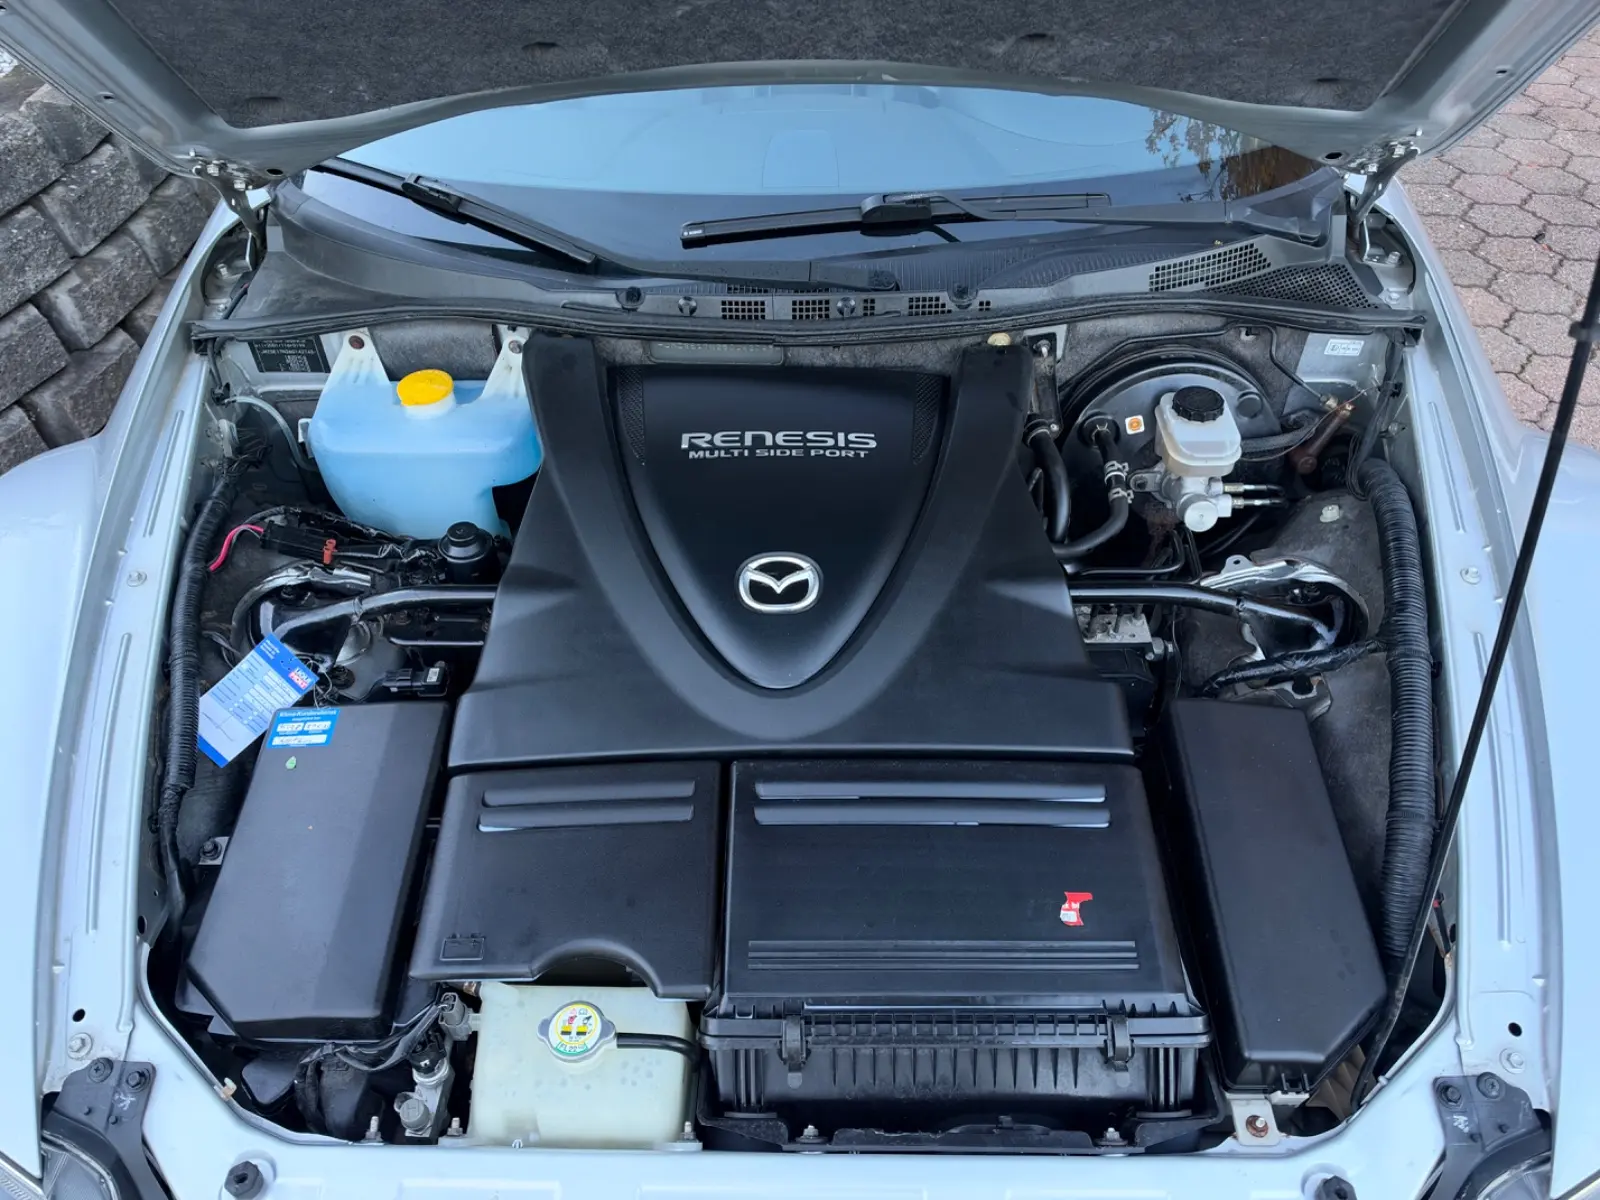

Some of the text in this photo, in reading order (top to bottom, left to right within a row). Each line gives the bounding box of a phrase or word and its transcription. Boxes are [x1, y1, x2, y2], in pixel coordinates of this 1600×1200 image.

[681, 431, 877, 449] RENESIS
[688, 448, 869, 459] MULTI SIDE PORT
